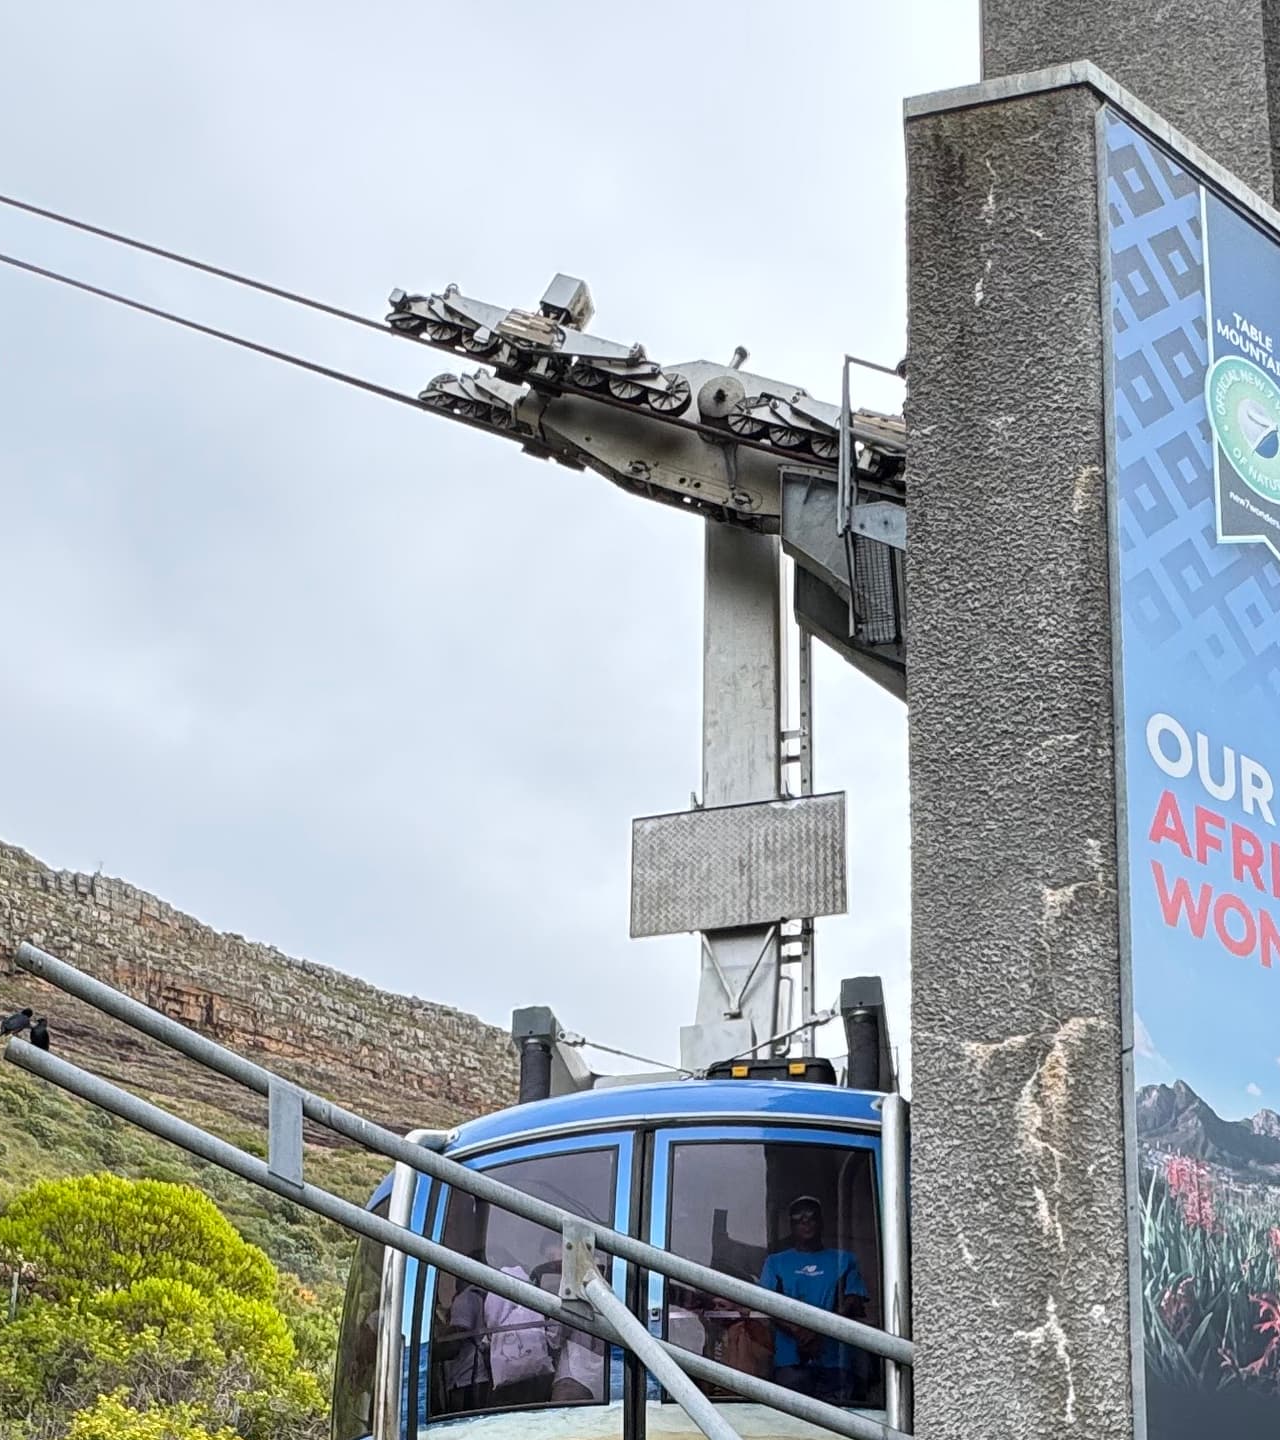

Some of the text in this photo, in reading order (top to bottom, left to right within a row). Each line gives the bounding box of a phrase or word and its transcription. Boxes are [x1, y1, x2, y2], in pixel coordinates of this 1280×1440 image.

[1232, 312, 1273, 353] TABLE
[1216, 369, 1241, 416] OFFICIAL
[1239, 369, 1267, 394] NEW
[1233, 447, 1247, 467] OF
[1146, 712, 1276, 826] OUR
